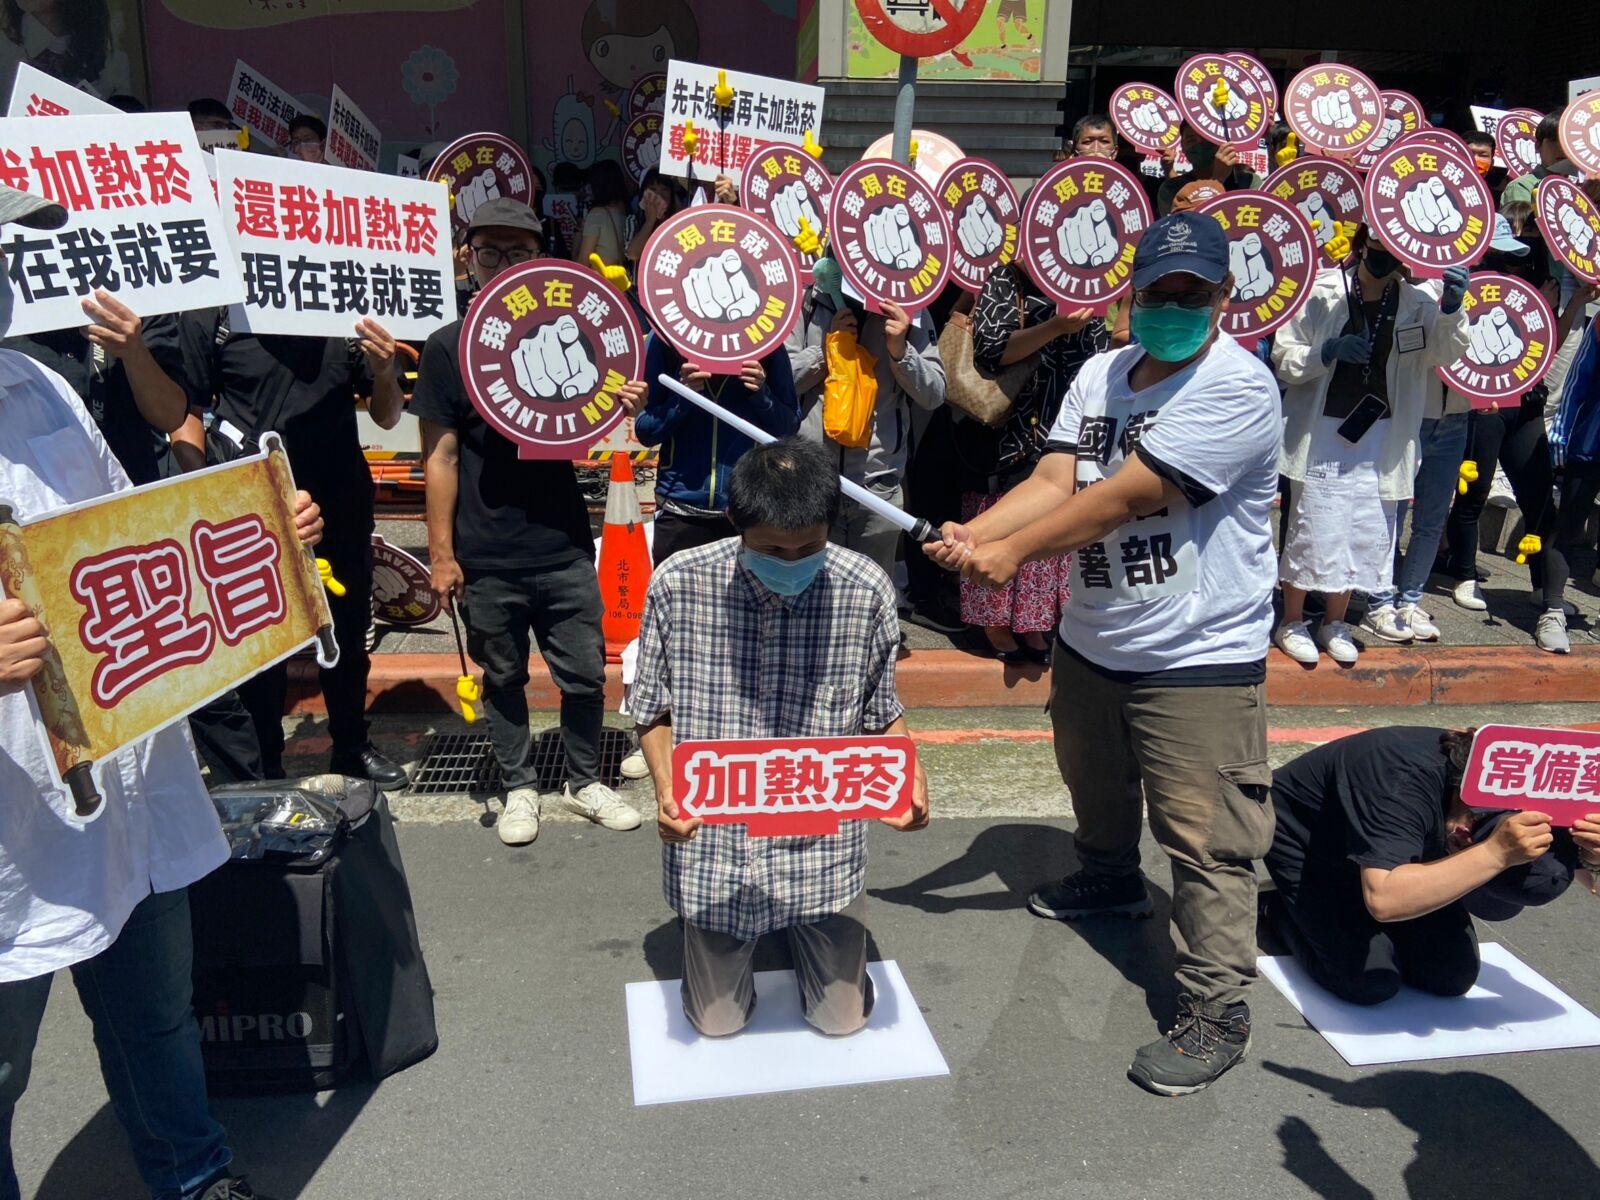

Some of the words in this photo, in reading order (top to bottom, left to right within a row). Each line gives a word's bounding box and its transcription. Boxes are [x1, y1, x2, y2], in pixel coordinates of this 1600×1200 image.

[237, 72, 302, 124] 菸防法過
[1184, 62, 1257, 101] 我現在就要
[1296, 72, 1377, 116] 我現在就要
[1117, 88, 1180, 122] 我現在就要
[1190, 105, 1201, 113] I
[1197, 114, 1232, 138] WANT
[1234, 125, 1248, 138] IT
[1245, 100, 1262, 131] NOW
[1294, 110, 1326, 142] WANT
[1327, 135, 1341, 146] IT
[1344, 119, 1373, 145] NOW
[668, 123, 768, 171] 奪我選擇
[1121, 119, 1148, 144] WANT
[1150, 137, 1160, 146] IT
[1160, 124, 1180, 146] NOW
[1377, 152, 1482, 208] 我現在就要
[1503, 142, 1525, 172] WANT
[842, 173, 944, 246] 我現在就要
[1035, 170, 1143, 234] 我現在就要
[1545, 193, 1559, 231] WANT
[1551, 187, 1560, 199] I
[233, 177, 438, 257] 還我加熱菸
[842, 225, 857, 233] I
[1034, 236, 1050, 244] I
[1385, 216, 1431, 259] WANT
[1436, 245, 1452, 261] IT
[1453, 214, 1483, 255] NOW
[654, 219, 788, 286] 我現在就要
[953, 249, 985, 281] WANT
[998, 223, 1017, 267] NOW
[1103, 242, 1136, 288] NOW
[1555, 235, 1568, 249] IT
[1568, 249, 1594, 273] NOW
[241, 251, 444, 321] 現在我就要
[846, 240, 887, 292] WANT
[891, 280, 906, 297] IT
[909, 253, 942, 295] NOW
[1038, 248, 1080, 294] WANT
[1084, 277, 1101, 296] IT
[655, 288, 673, 296] I
[1231, 312, 1250, 330] IT
[1255, 275, 1299, 323] NOW
[478, 279, 630, 358] 我現在就要
[660, 300, 715, 350] WANT
[744, 295, 787, 345] NOW
[721, 333, 741, 352] IT
[1495, 373, 1511, 390] IT
[1512, 339, 1545, 381] NOW
[480, 362, 501, 373] I
[486, 376, 549, 434] WANT
[581, 368, 627, 426] NOW
[555, 413, 577, 436] IT
[617, 559, 630, 610] 北市警局
[73, 516, 286, 704] 聖旨
[688, 751, 901, 811] 加熱菸
